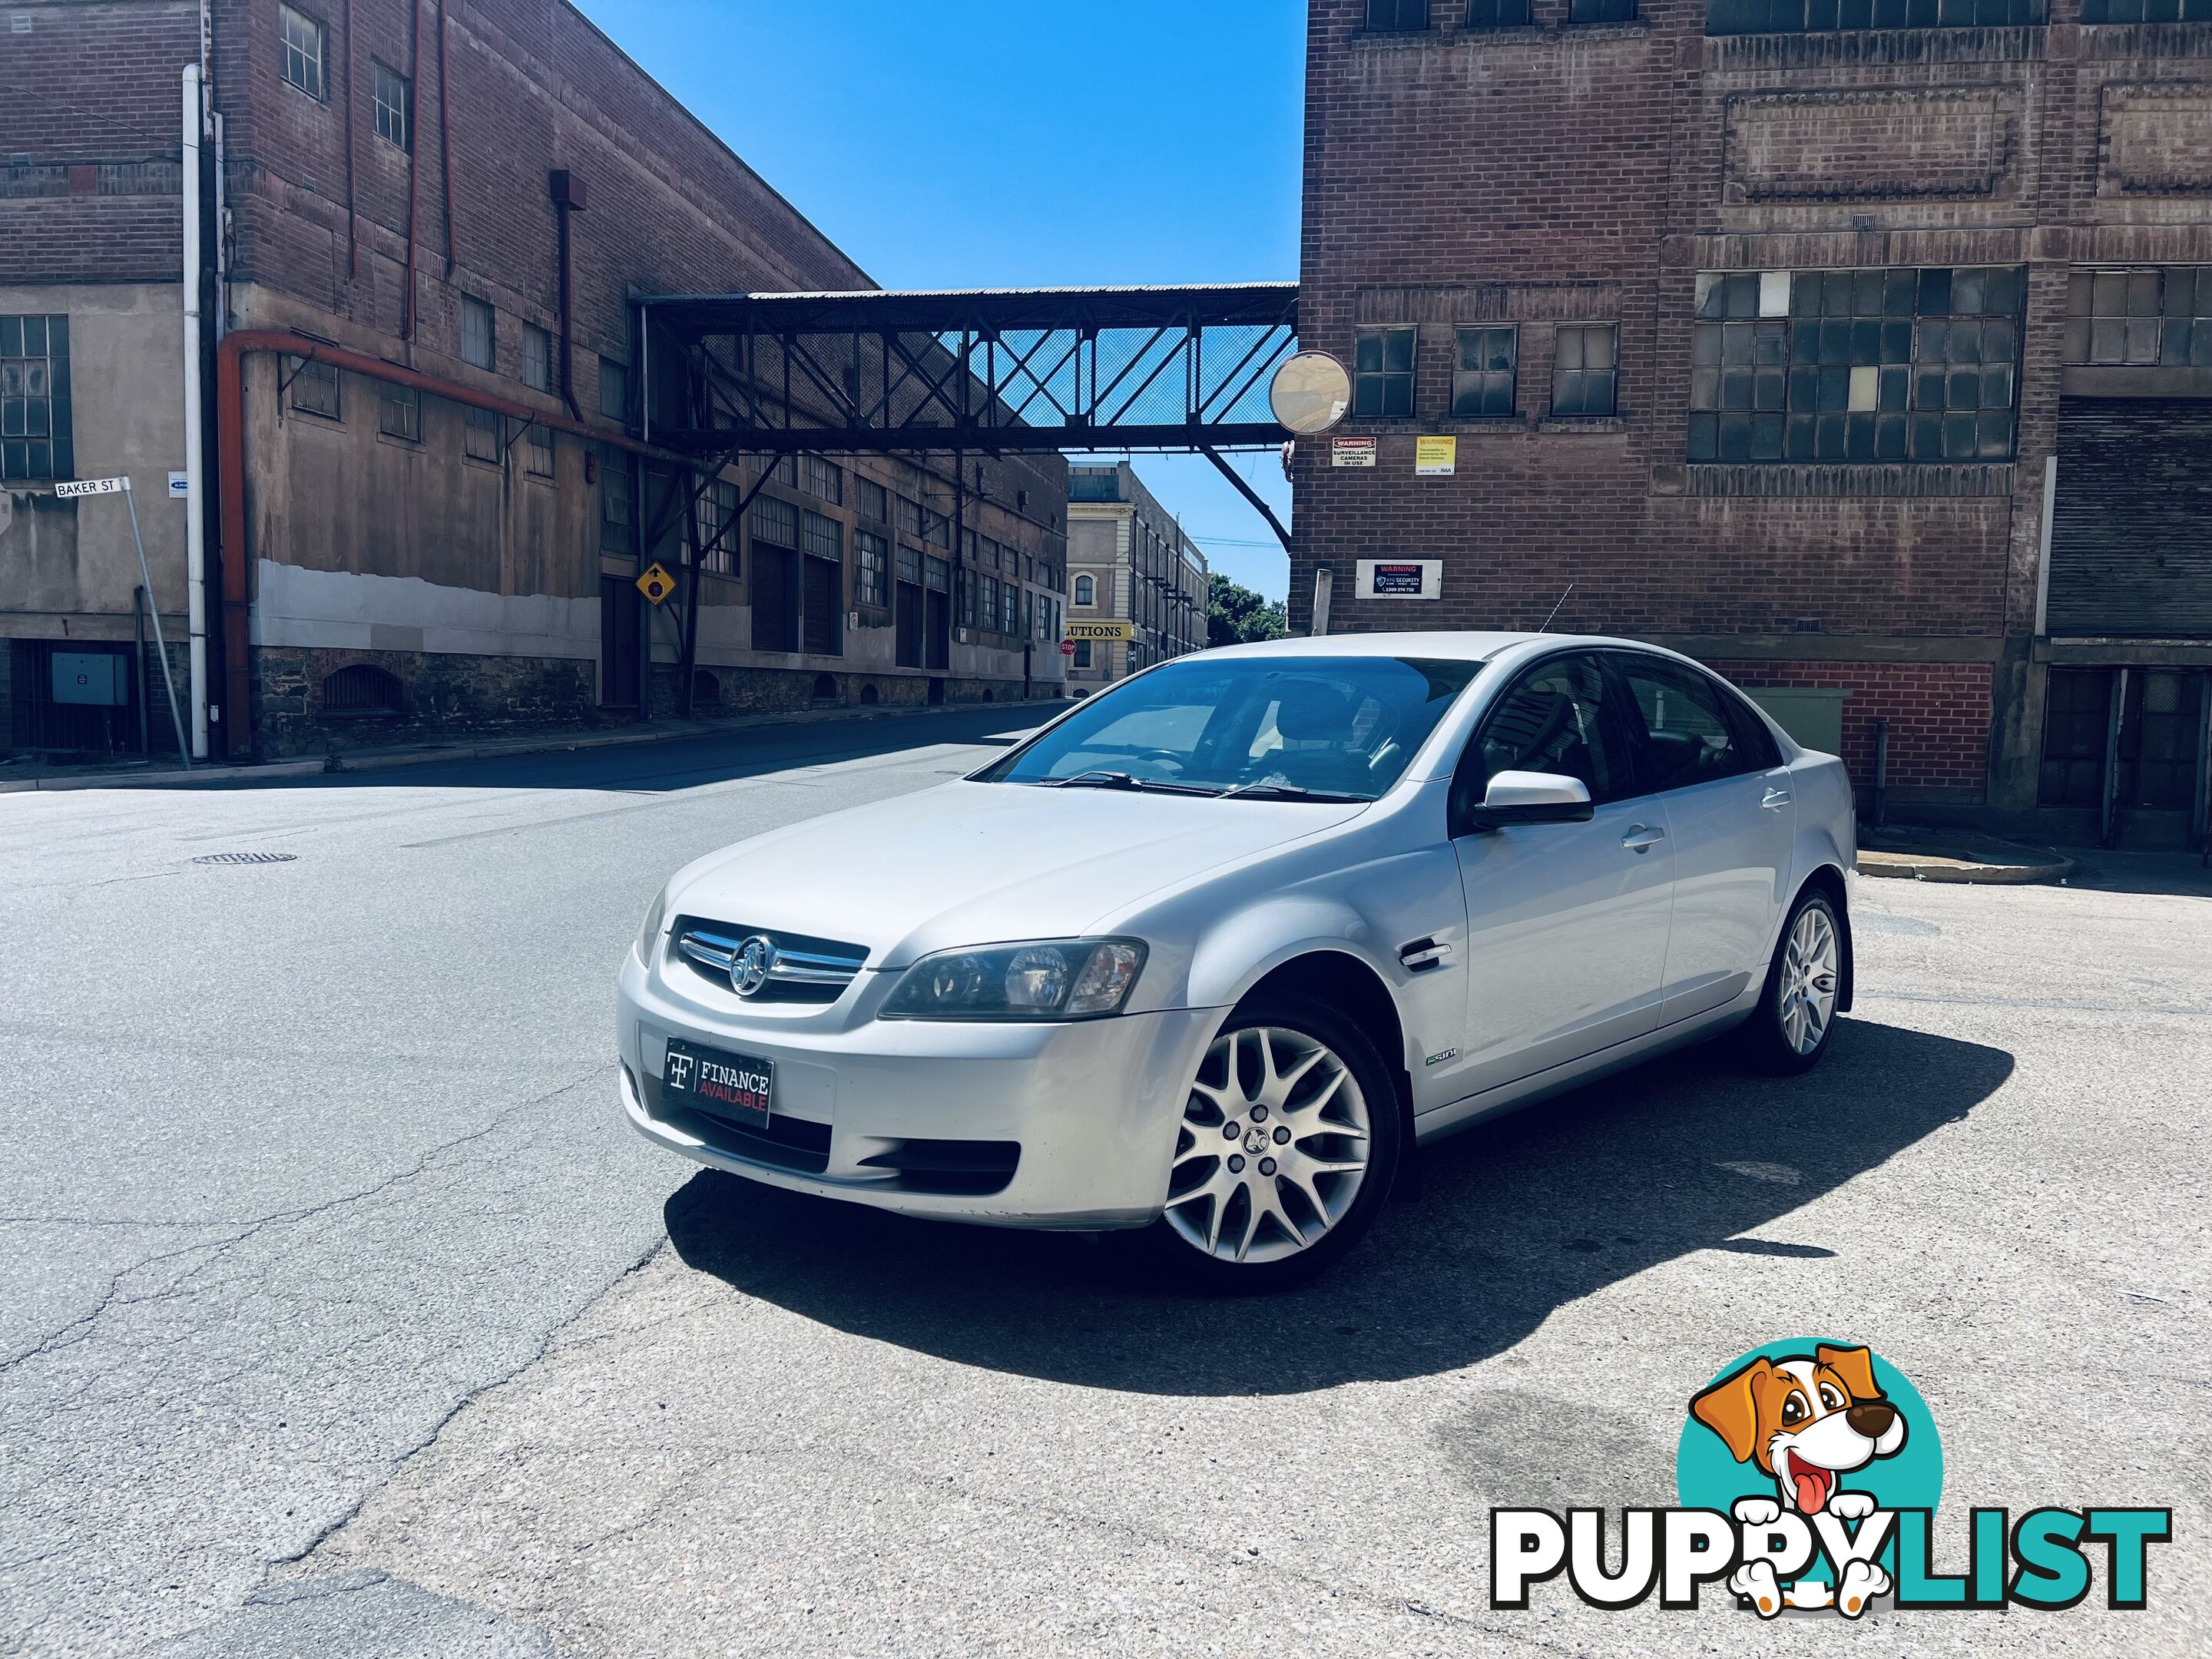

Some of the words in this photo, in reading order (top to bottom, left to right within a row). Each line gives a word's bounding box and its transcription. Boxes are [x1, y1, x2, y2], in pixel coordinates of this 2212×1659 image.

[58, 482, 97, 495] BAKER
[101, 481, 114, 491] ST
[700, 1061, 769, 1095] FINANCE
[699, 1080, 767, 1112] AVAILABLE
